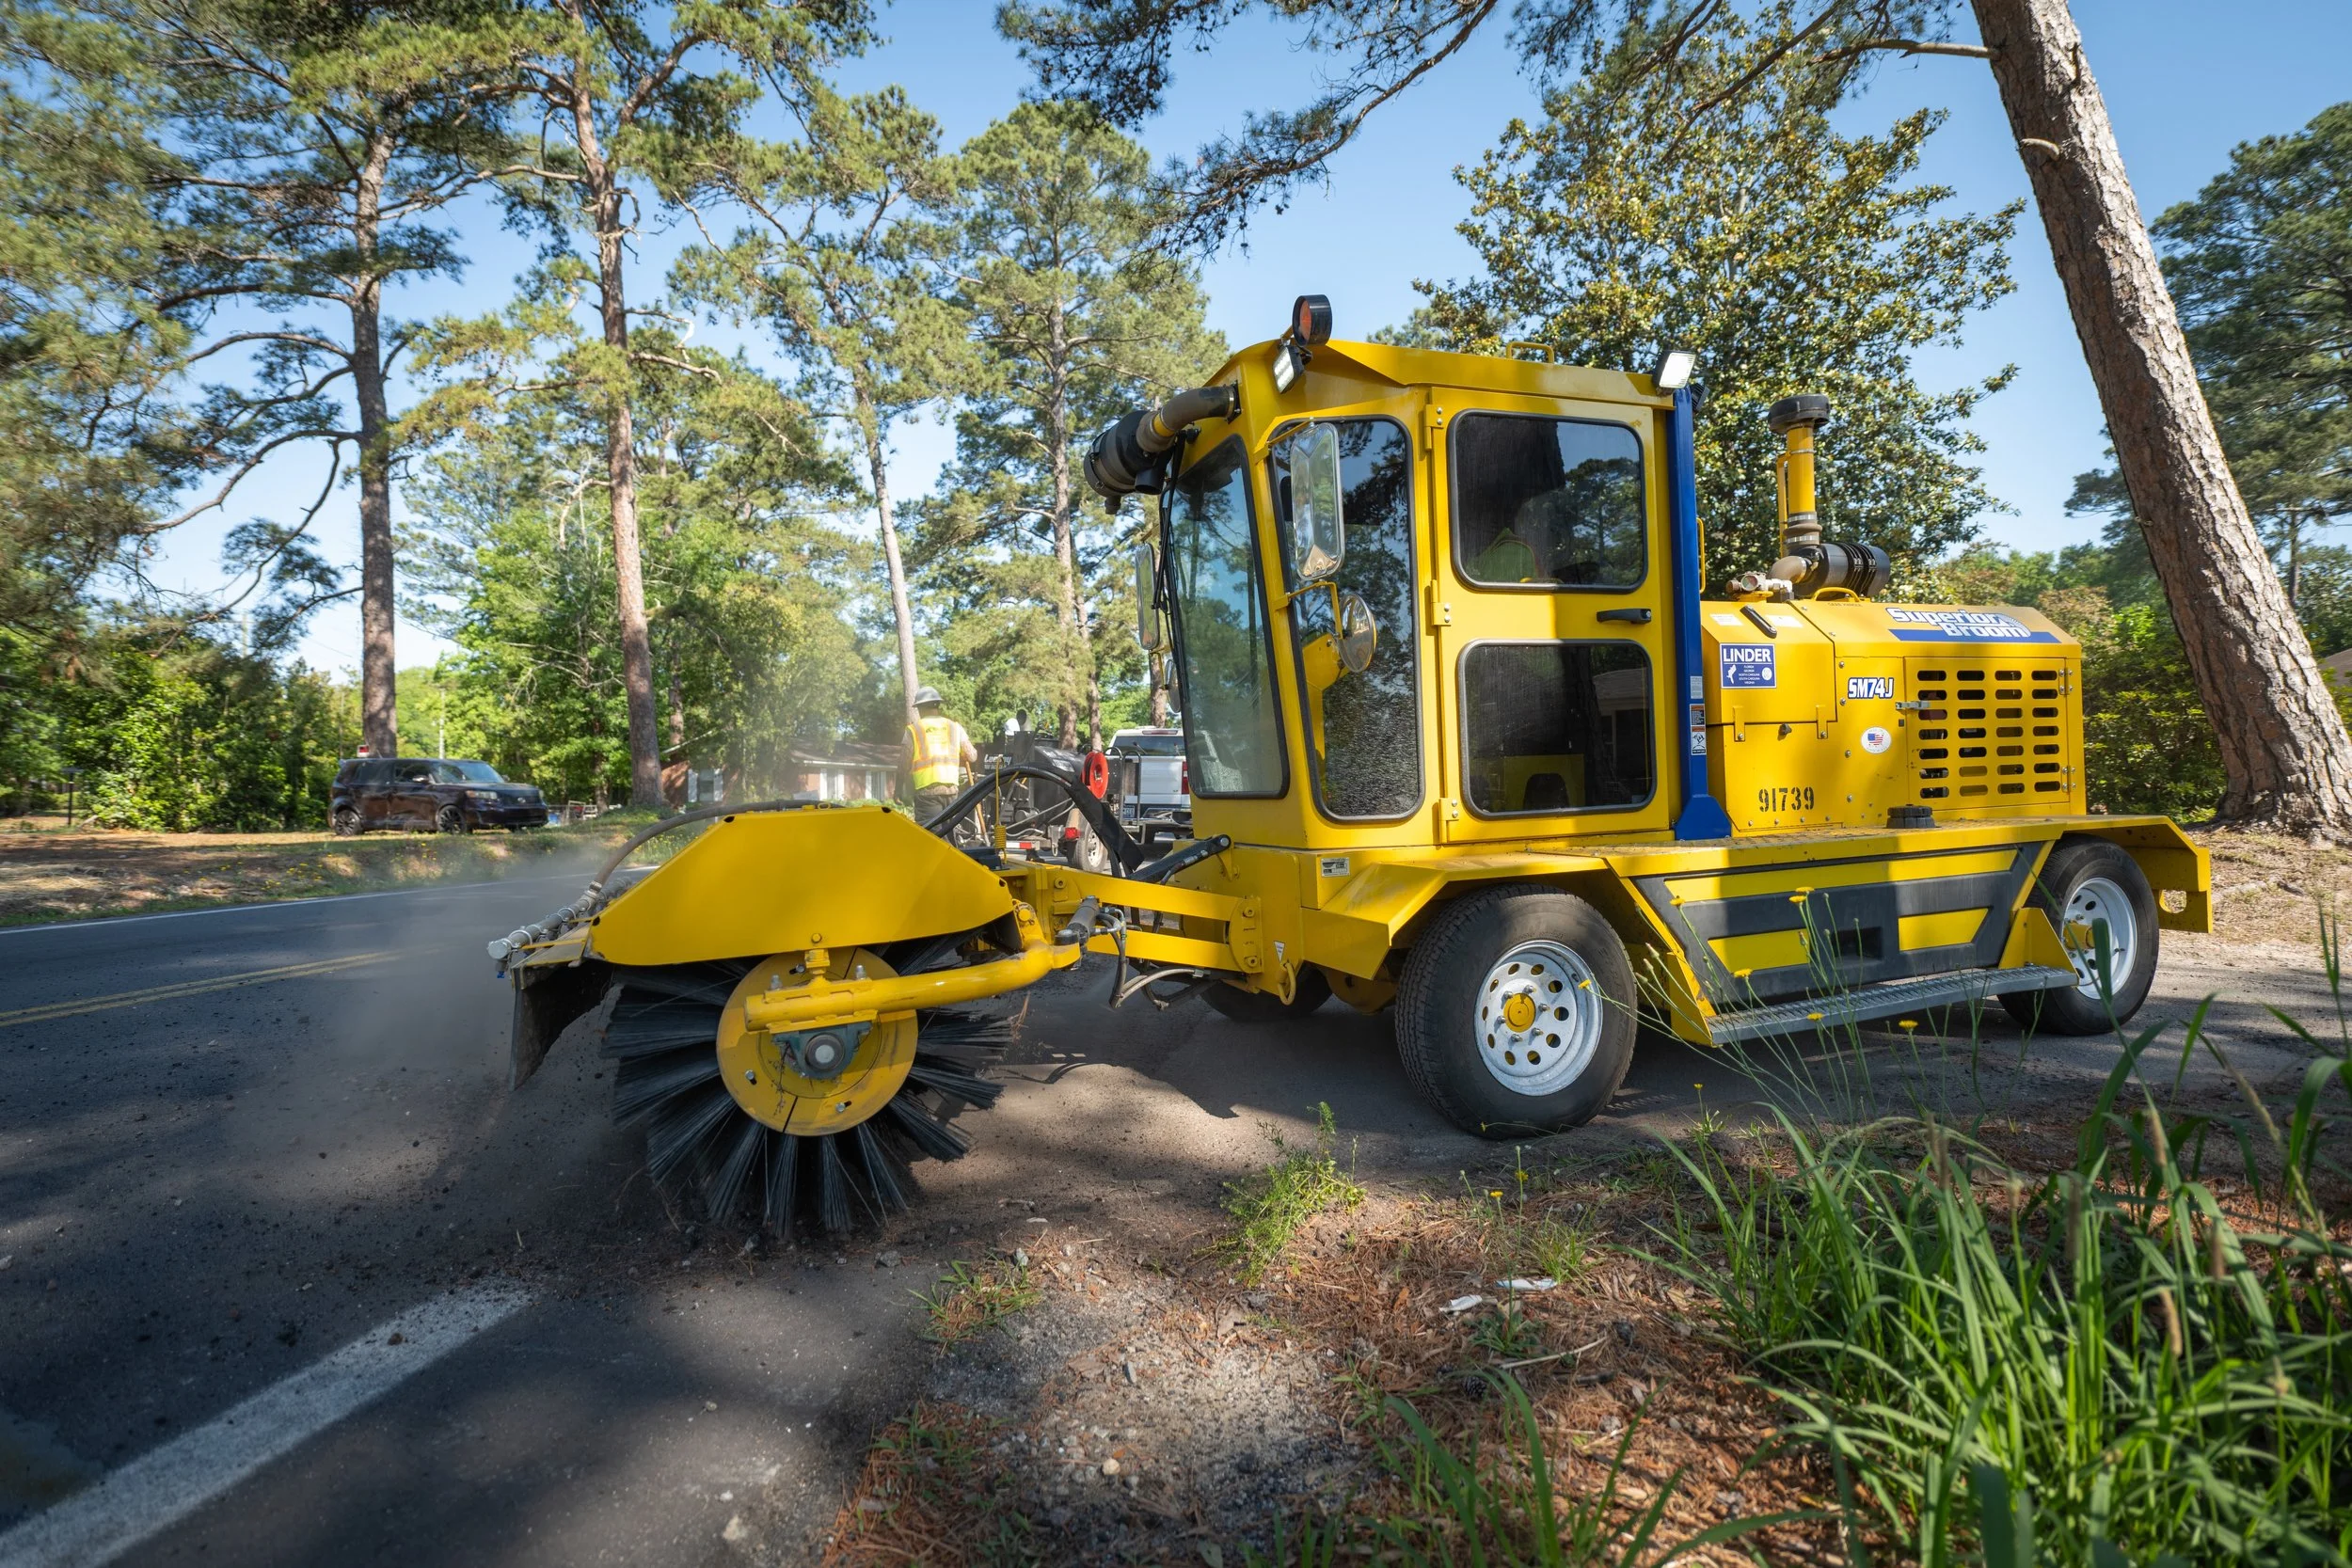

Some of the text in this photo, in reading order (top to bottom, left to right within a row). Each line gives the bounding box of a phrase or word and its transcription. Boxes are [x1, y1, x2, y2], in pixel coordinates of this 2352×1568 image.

[1885, 608, 2002, 626] Superior
[1938, 623, 2031, 638] Broom
[1723, 648, 1772, 662] LINDER
[1848, 676, 1895, 699] SM74J
[1758, 786, 1815, 812] 91739
